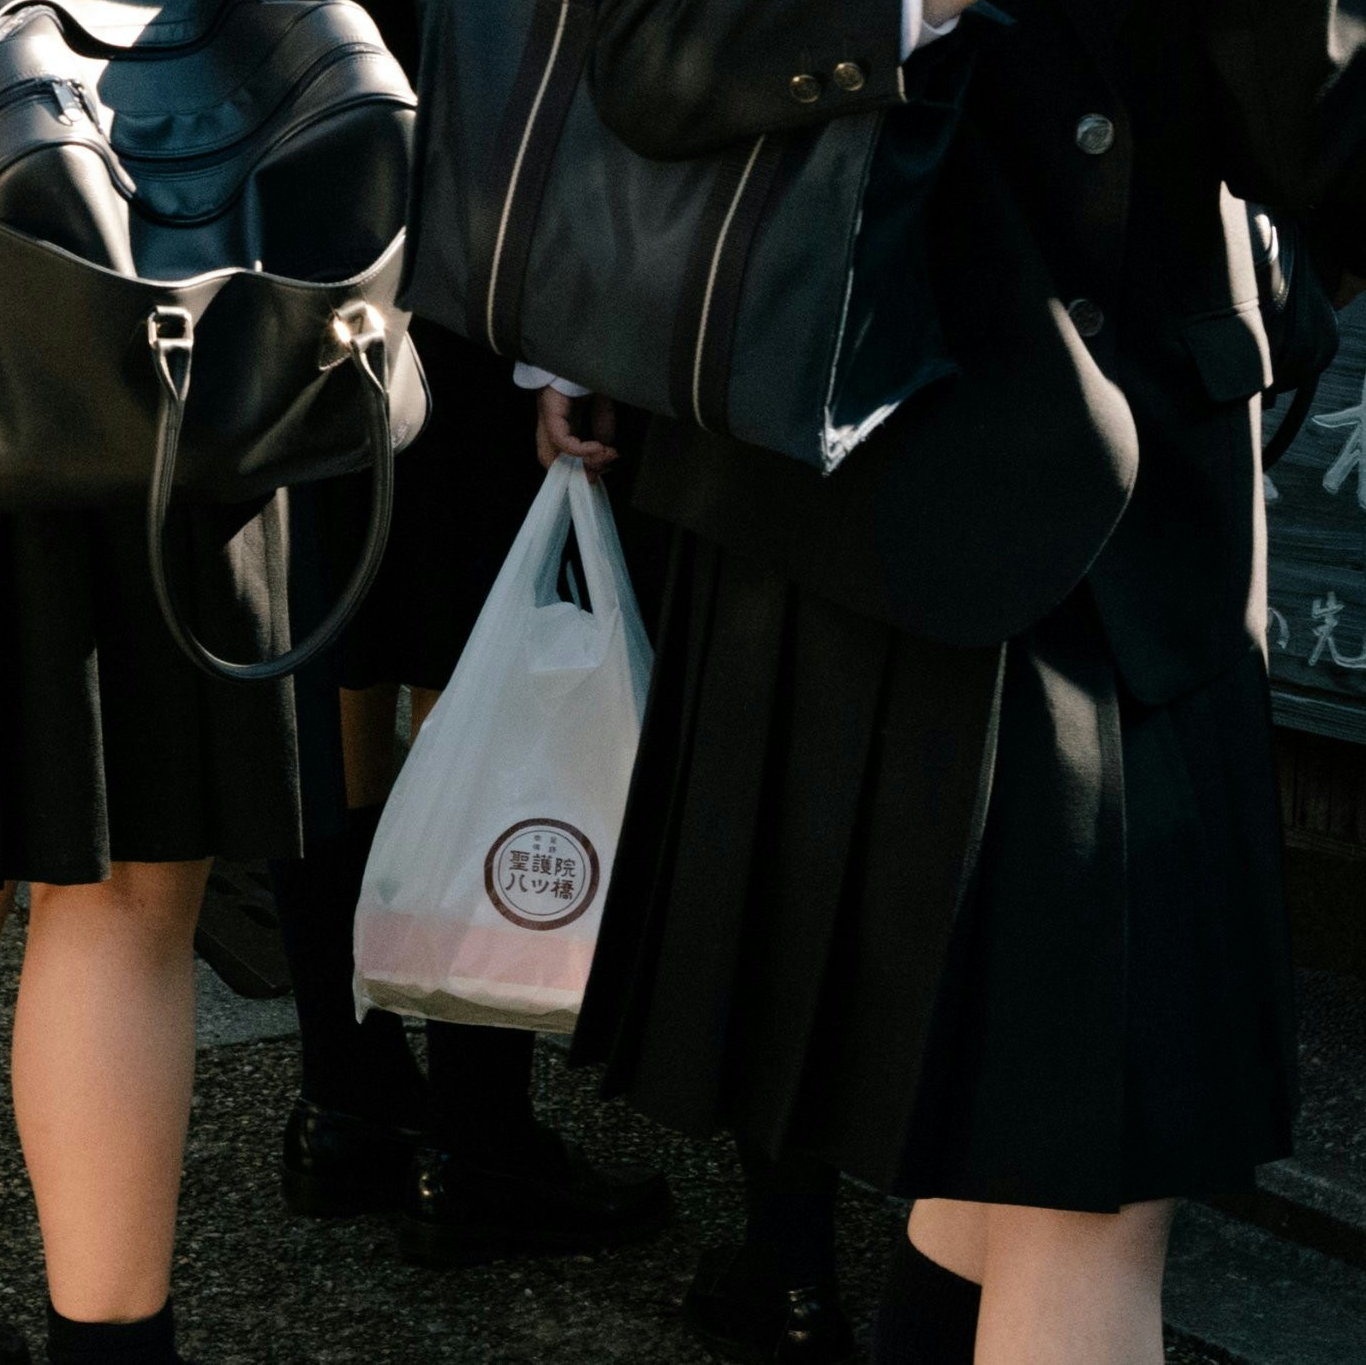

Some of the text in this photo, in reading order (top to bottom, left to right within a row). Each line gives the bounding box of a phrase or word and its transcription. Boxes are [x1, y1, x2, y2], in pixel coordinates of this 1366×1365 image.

[509, 849, 577, 878] 聖護院
[505, 873, 575, 900] 八ツ橋
